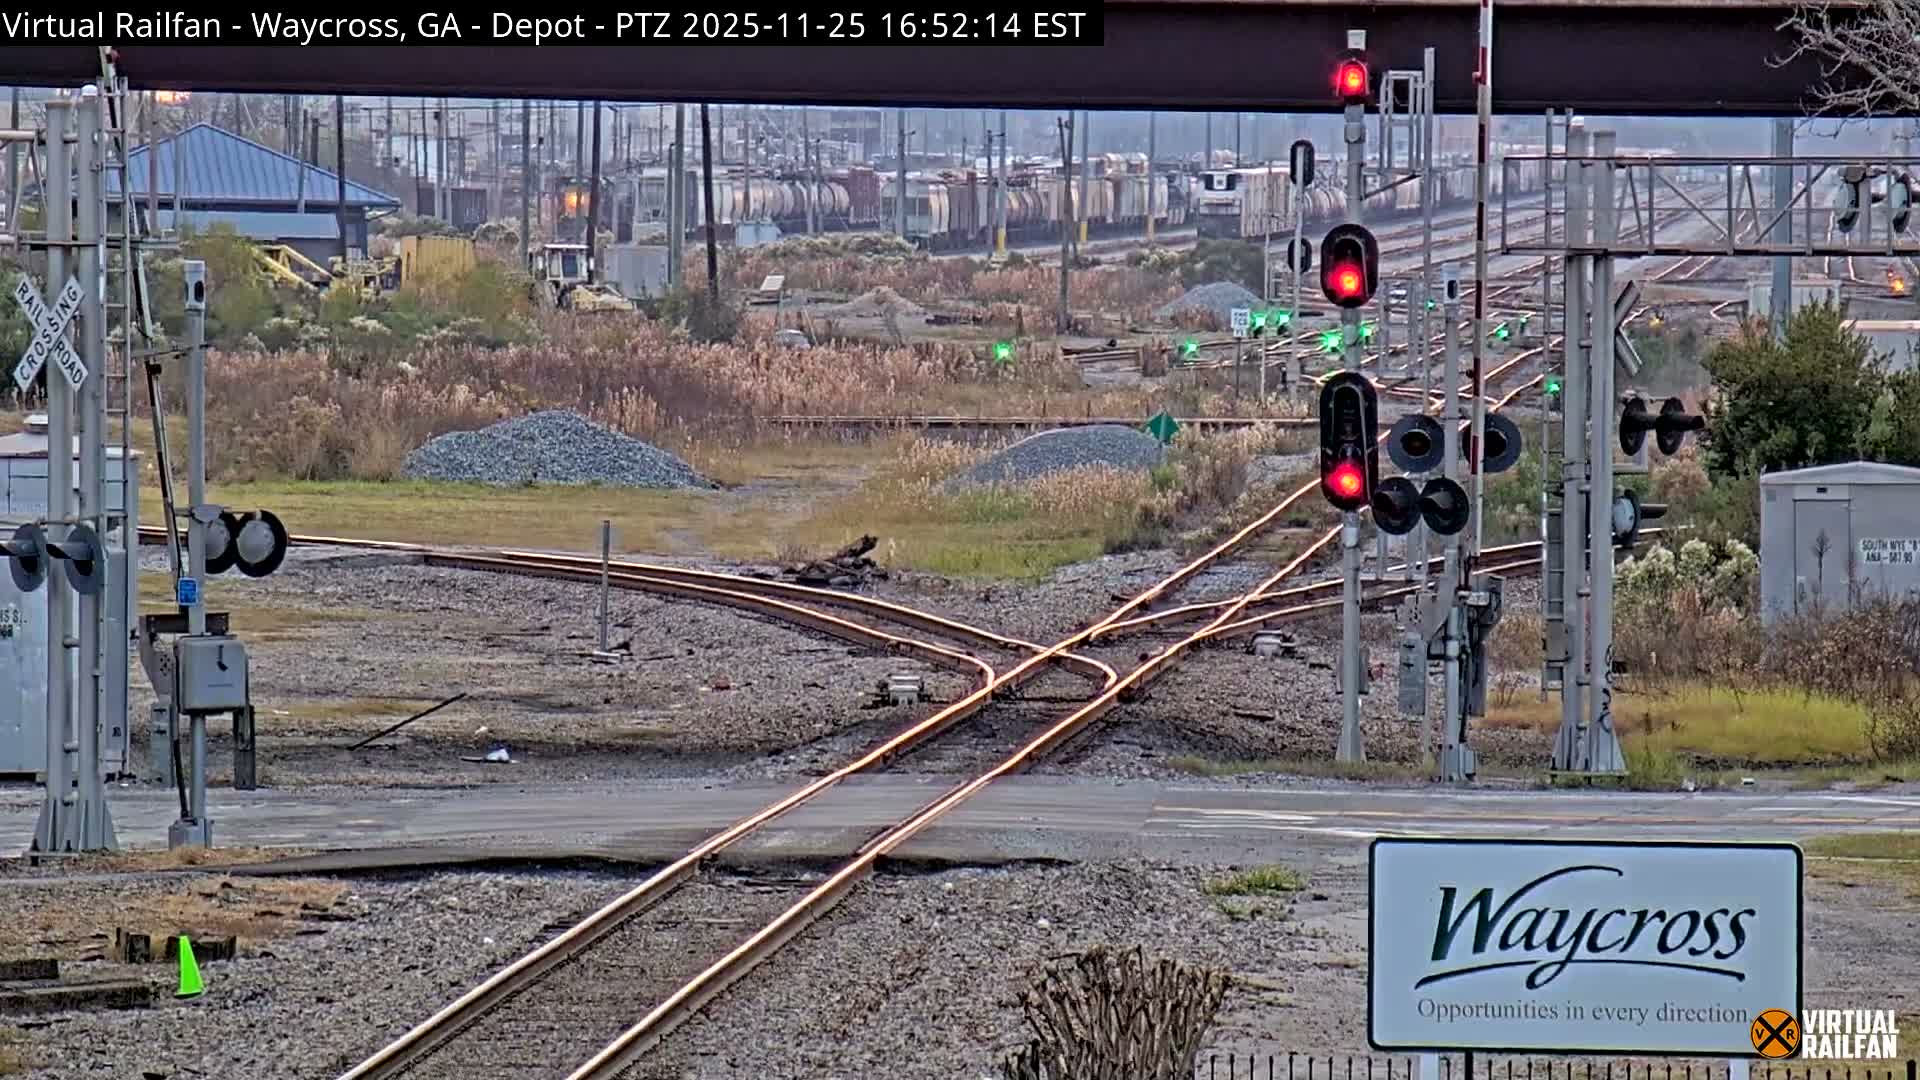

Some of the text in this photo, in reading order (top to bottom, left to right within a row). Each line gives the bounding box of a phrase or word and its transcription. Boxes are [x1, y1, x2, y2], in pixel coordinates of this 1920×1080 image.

[18, 282, 43, 327] RAIL
[20, 285, 78, 381] CROSSING
[54, 340, 83, 384] ROAD
[1862, 539, 1888, 551] SOUTH
[1430, 865, 1756, 990] Waycross
[1417, 998, 1559, 1022] Opportunities
[1566, 999, 1585, 1021] in
[1592, 1003, 1649, 1026] every
